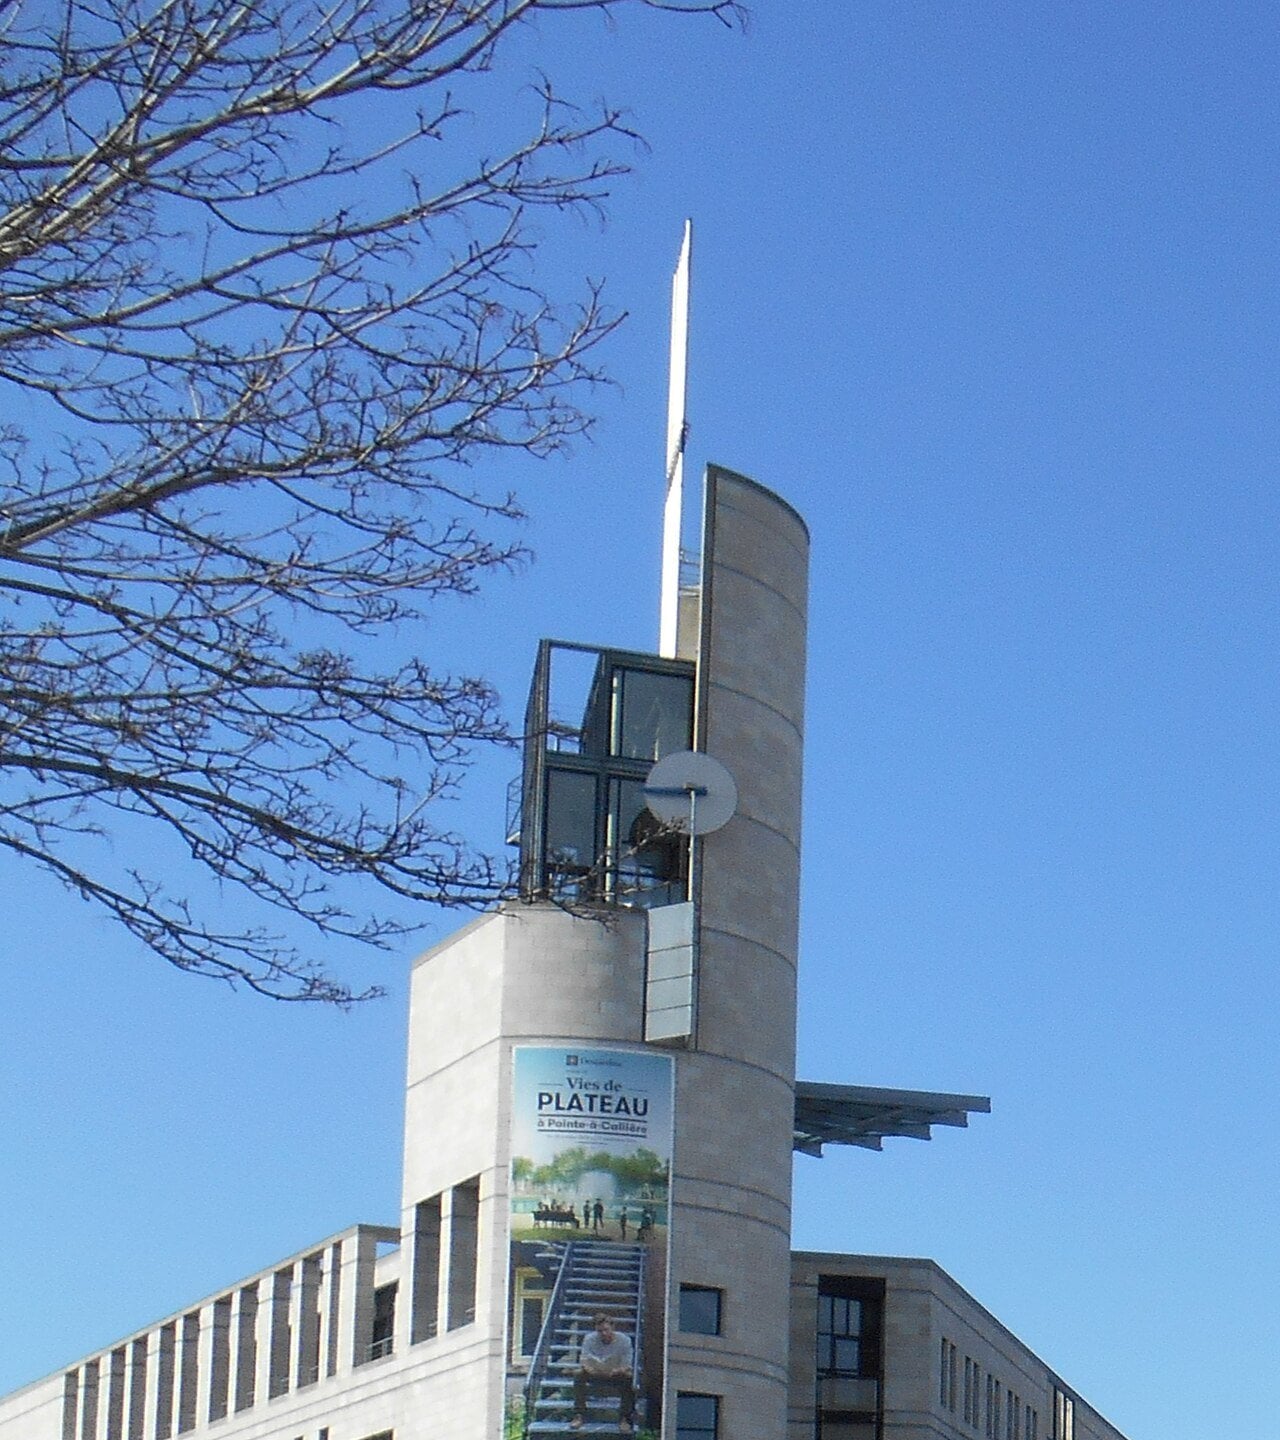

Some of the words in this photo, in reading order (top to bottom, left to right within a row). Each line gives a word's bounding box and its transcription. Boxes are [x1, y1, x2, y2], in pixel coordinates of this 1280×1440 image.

[566, 1077, 600, 1090] Vies
[603, 1080, 622, 1092] de
[537, 1092, 648, 1117] PLATEAU
